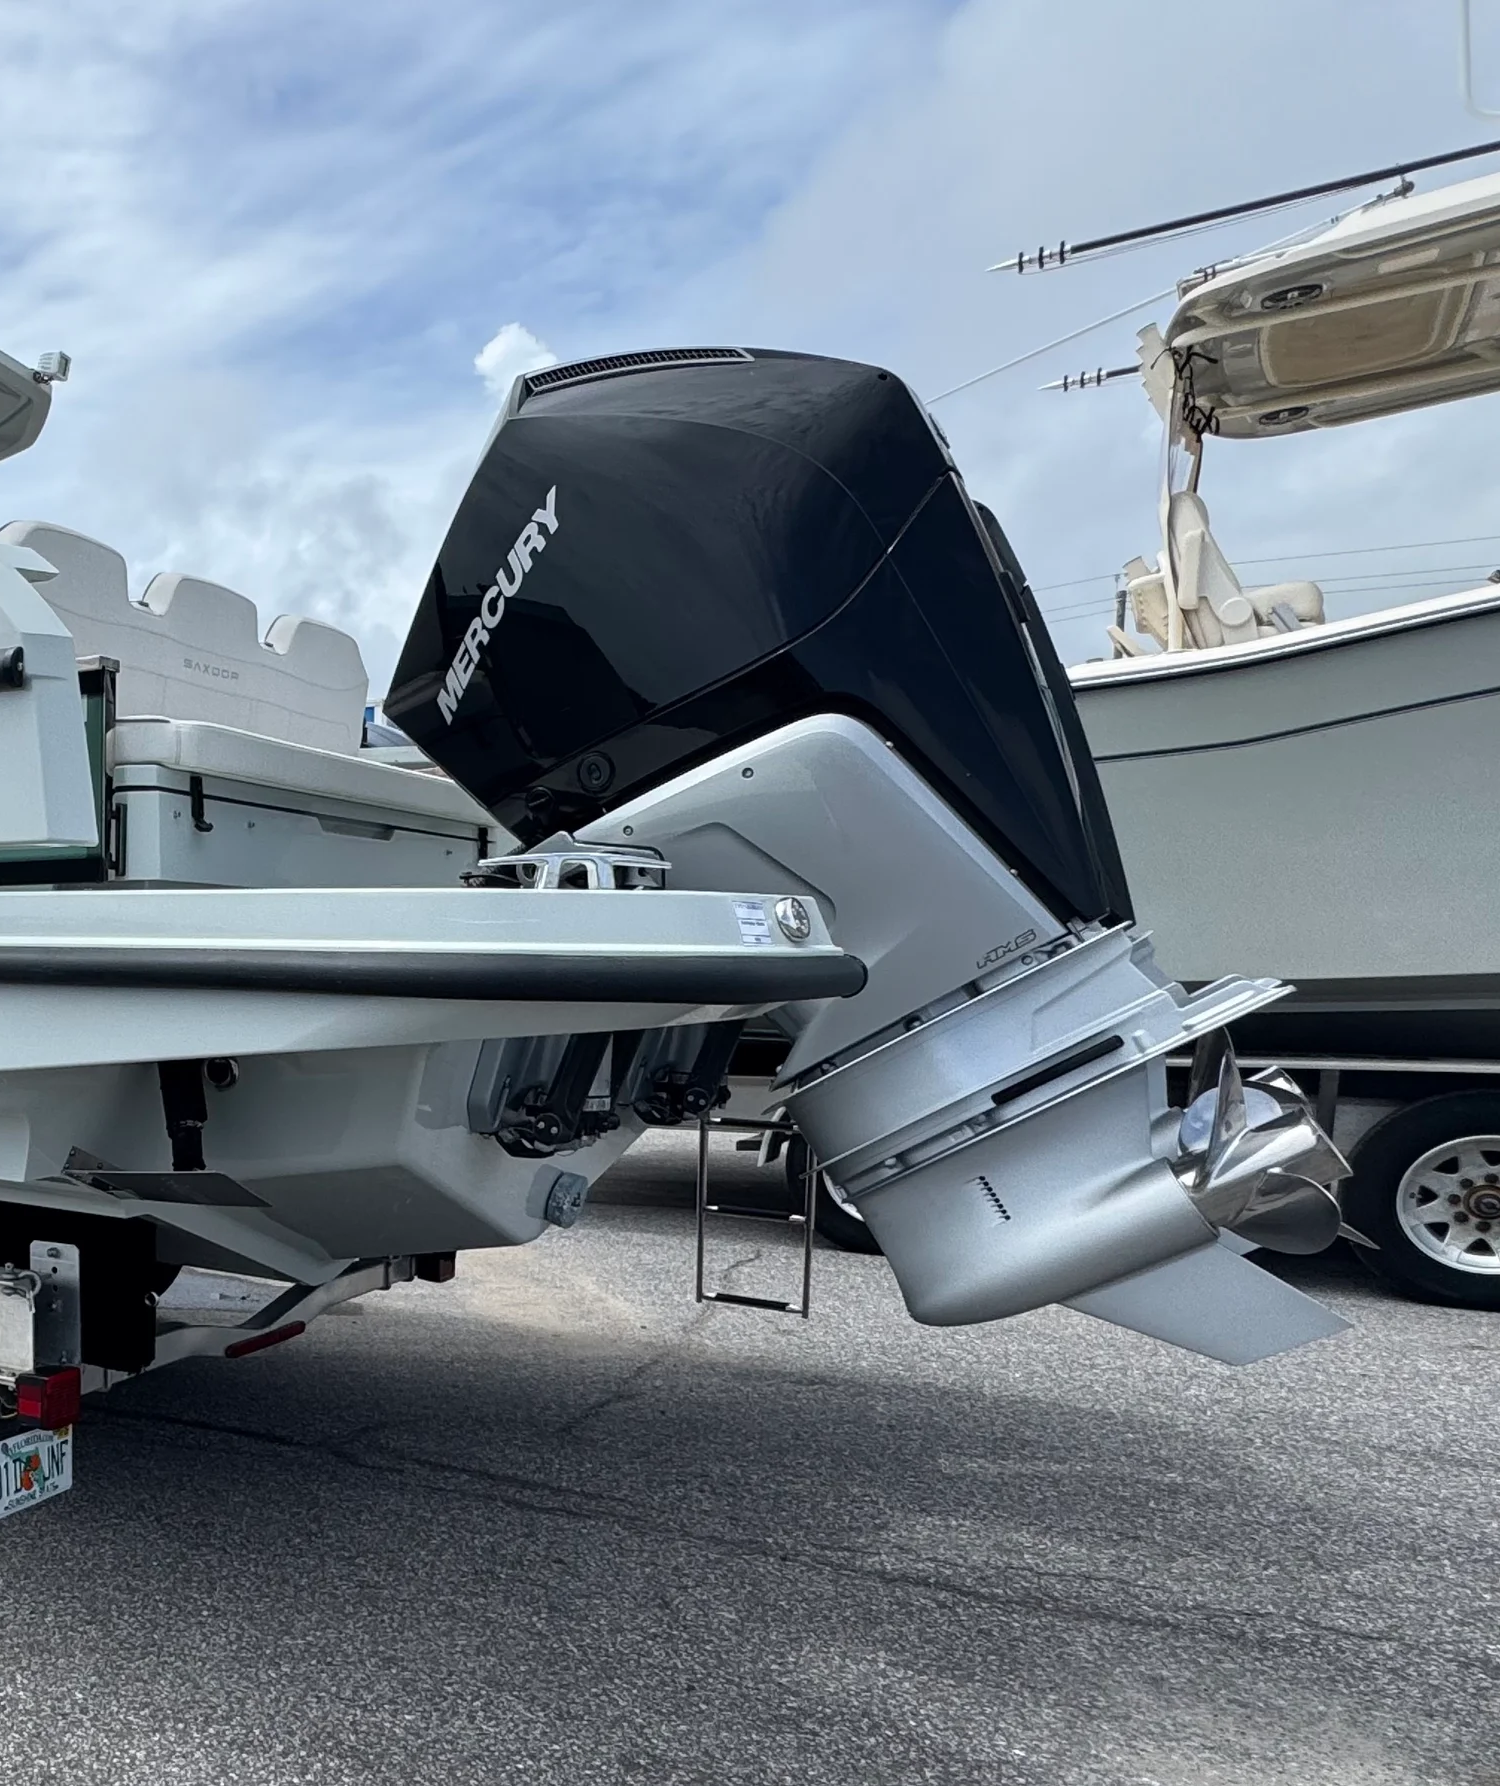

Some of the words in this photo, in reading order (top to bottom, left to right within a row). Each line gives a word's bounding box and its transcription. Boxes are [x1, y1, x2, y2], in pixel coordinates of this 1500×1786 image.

[437, 485, 559, 725] MERCURY
[183, 658, 239, 680] SAXDOR
[976, 929, 1037, 970] AMS
